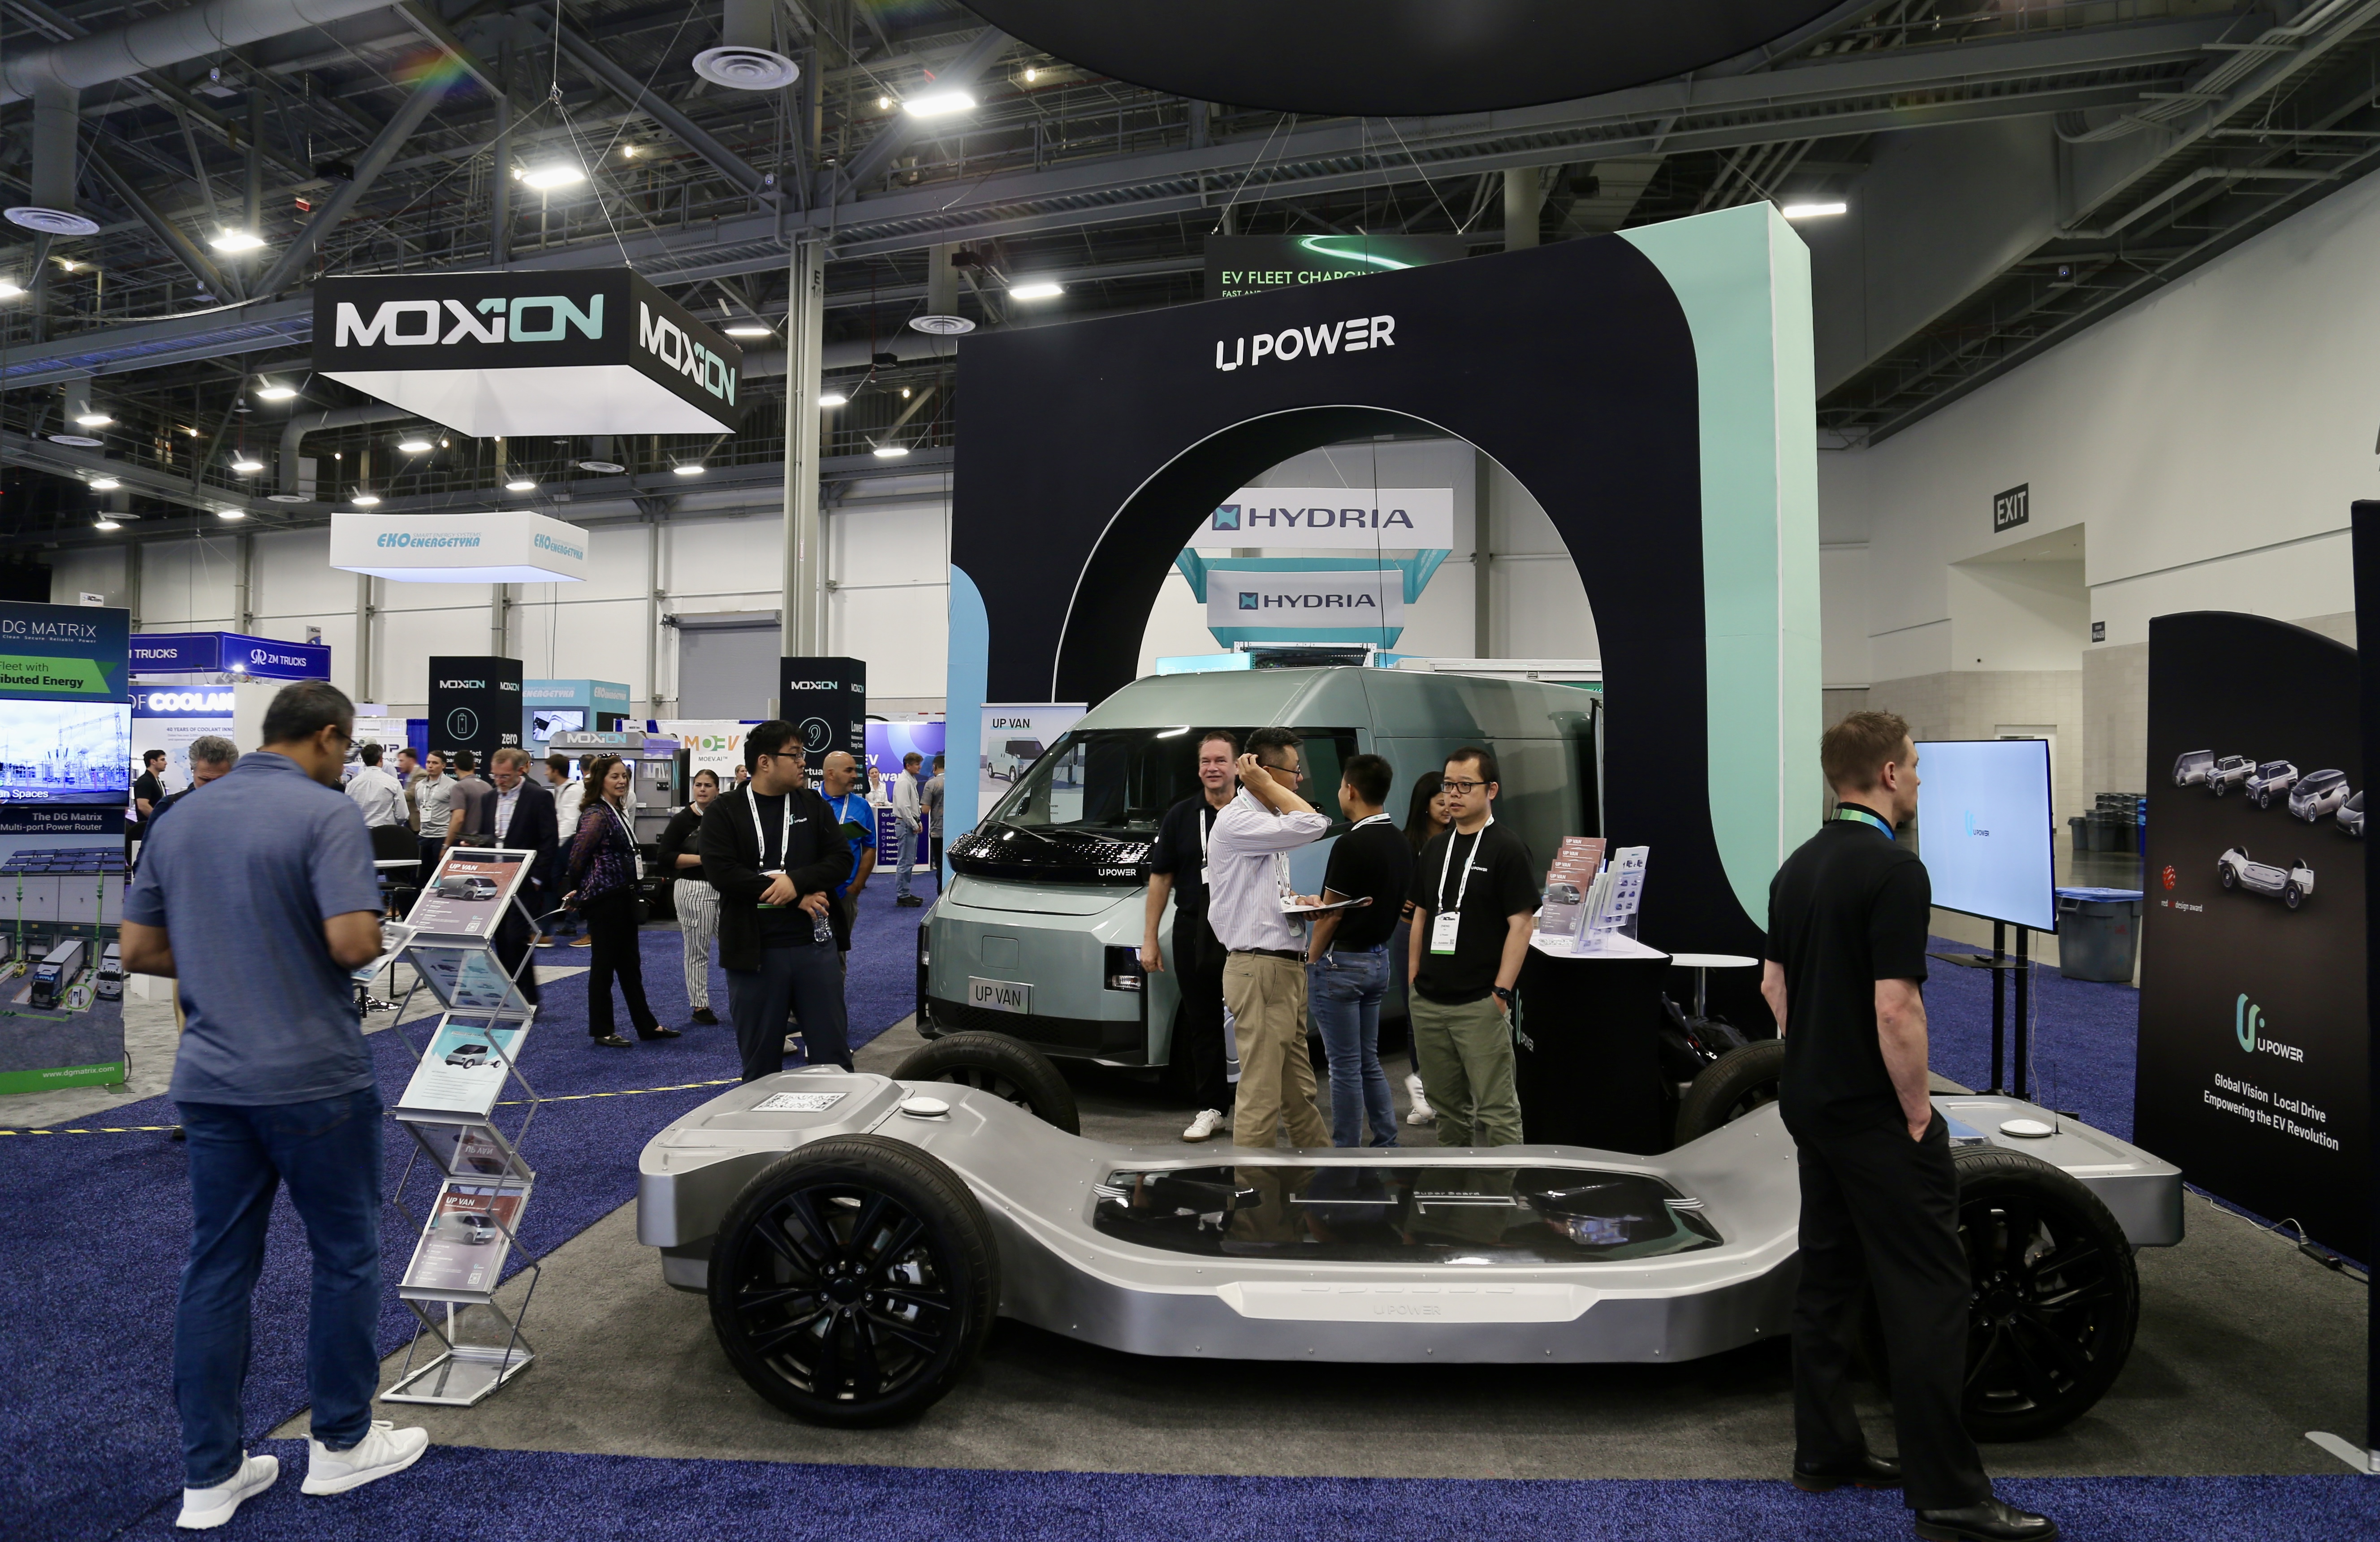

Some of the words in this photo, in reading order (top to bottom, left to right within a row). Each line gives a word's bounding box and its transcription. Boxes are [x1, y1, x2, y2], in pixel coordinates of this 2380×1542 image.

[1222, 271, 1243, 284] EV
[1248, 271, 1293, 284] FLEET
[335, 294, 604, 347] MOXION
[639, 301, 736, 406] MOXION
[1997, 491, 2026, 525] EXIT
[1249, 508, 1414, 529] HYDRIA
[1264, 594, 1376, 608] HYDRIA
[3, 620, 26, 634] DG
[134, 648, 177, 659] TRUCKS
[268, 654, 279, 664] ZM
[280, 655, 307, 667] TRUCKS
[26, 663, 49, 672] with
[43, 676, 84, 688] Energy
[439, 680, 485, 688] MOXION
[500, 682, 519, 691] MOXION
[791, 681, 838, 689] MOXION
[851, 721, 863, 733] Lower
[992, 718, 1006, 728] UP
[1009, 718, 1030, 728] VAN
[501, 734, 518, 744] zero
[567, 733, 626, 743] MOXION
[13, 789, 49, 799] Spaces
[0, 824, 44, 832] Multi-port
[2175, 901, 2189, 911] design
[976, 985, 992, 1002] UP
[996, 988, 1020, 1006] VAN
[2267, 1040, 2303, 1063] POWER
[43, 1066, 115, 1078] www.dgmatrix.com
[2215, 1073, 2240, 1093] Global
[2242, 1082, 2268, 1102] Vision
[2274, 1093, 2299, 1113] Local
[2301, 1102, 2326, 1122] Drive
[2204, 1090, 2255, 1122] Empowering
[2257, 1110, 2272, 1125] the
[2273, 1114, 2286, 1131] EV
[2287, 1119, 2339, 1150] Revolution
[458, 1198, 475, 1206] VAN
